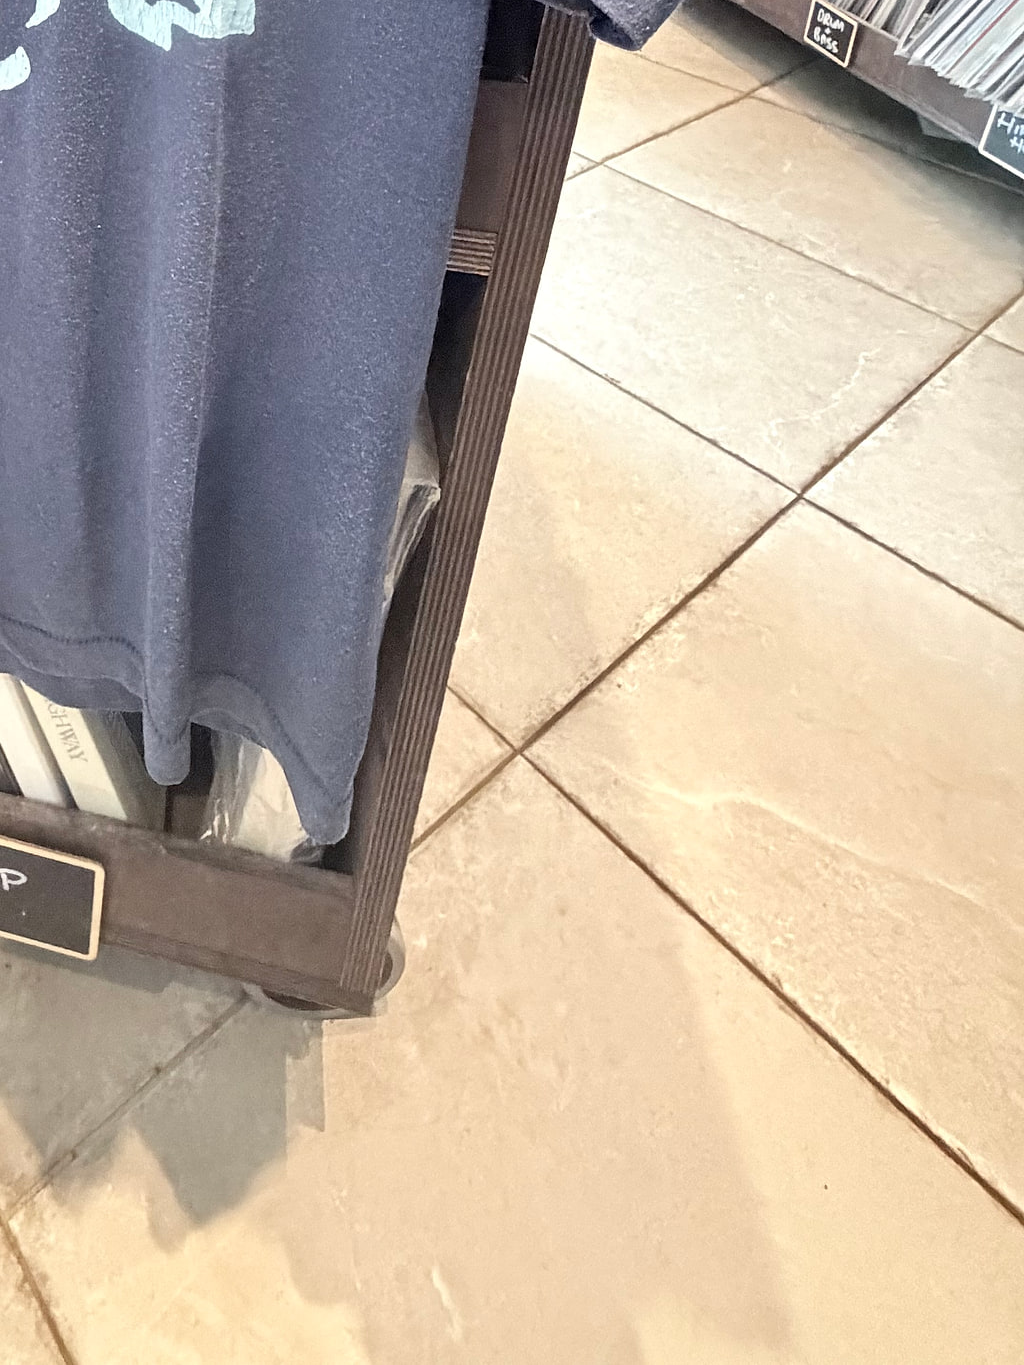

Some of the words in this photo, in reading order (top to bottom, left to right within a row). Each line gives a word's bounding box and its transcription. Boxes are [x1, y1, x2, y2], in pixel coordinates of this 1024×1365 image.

[817, 8, 845, 33] DRUM
[813, 26, 839, 54] BASS
[44, 700, 88, 763] GHWAY
